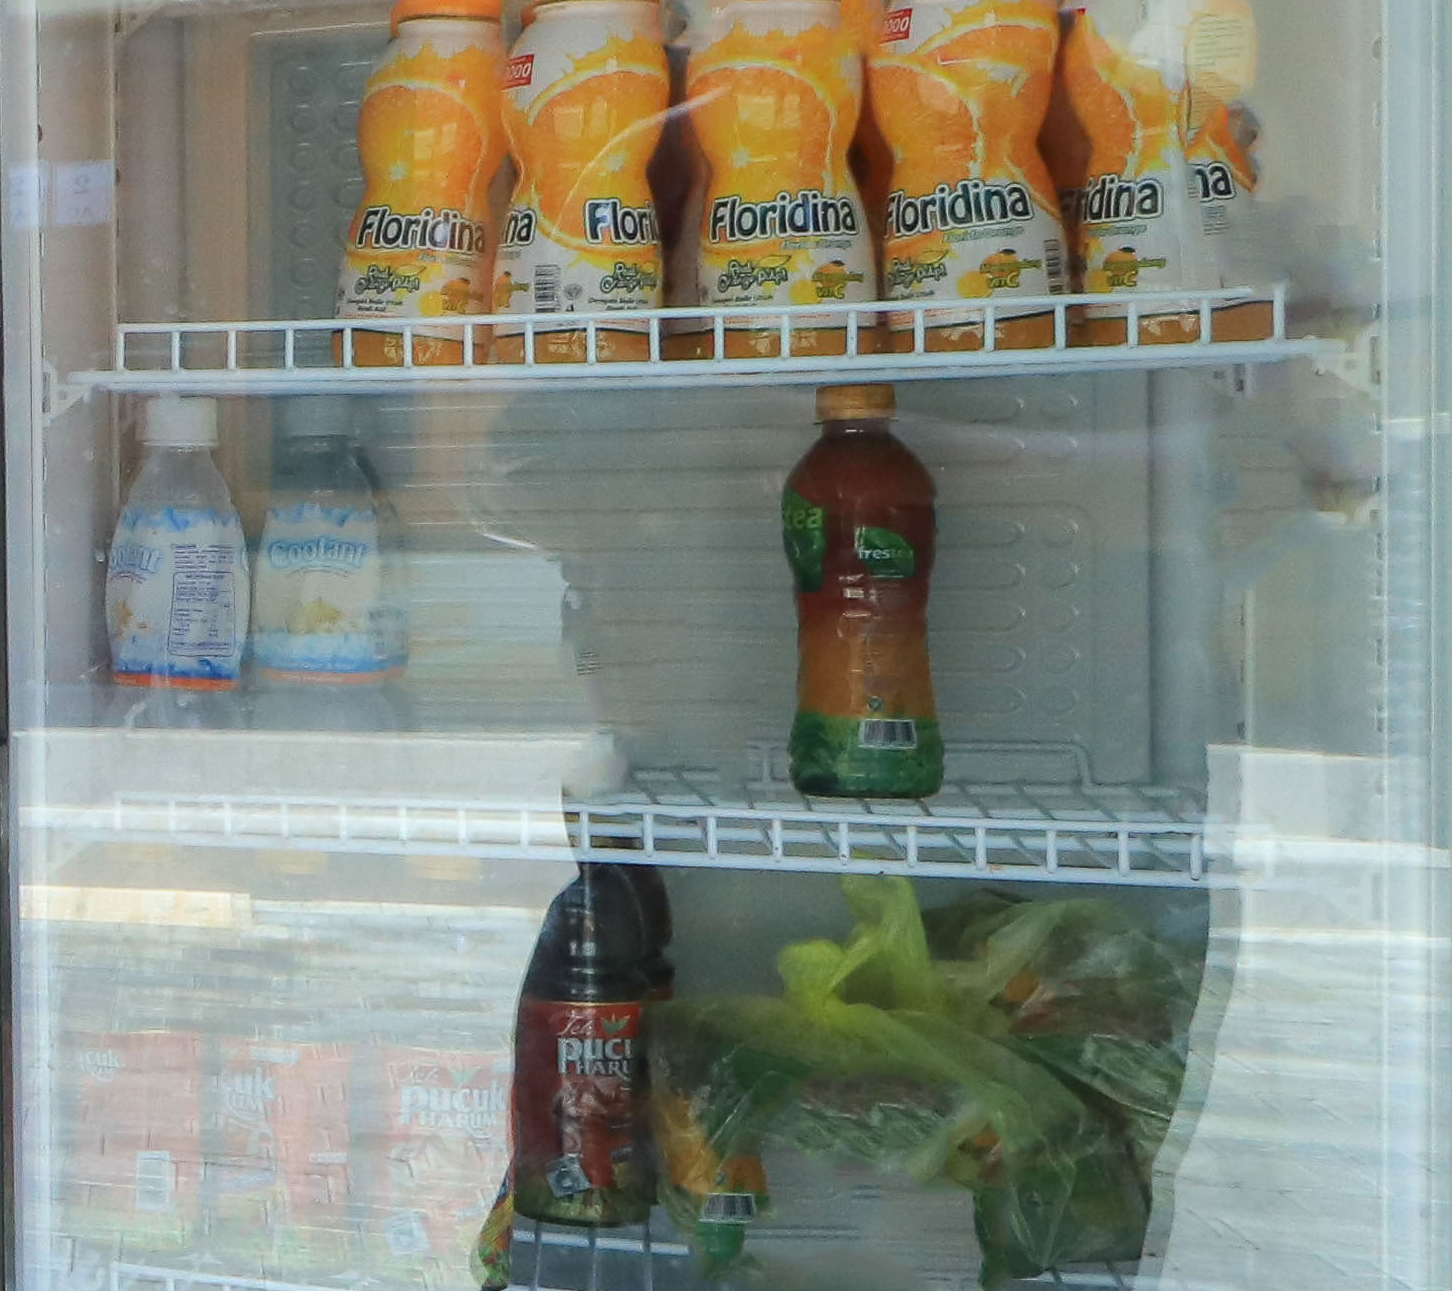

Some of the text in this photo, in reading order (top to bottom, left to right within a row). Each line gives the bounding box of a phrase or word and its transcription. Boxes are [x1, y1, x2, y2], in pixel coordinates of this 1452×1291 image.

[355, 205, 485, 254] Floridina
[709, 189, 859, 243] Floridina
[268, 536, 370, 569] Coolant
